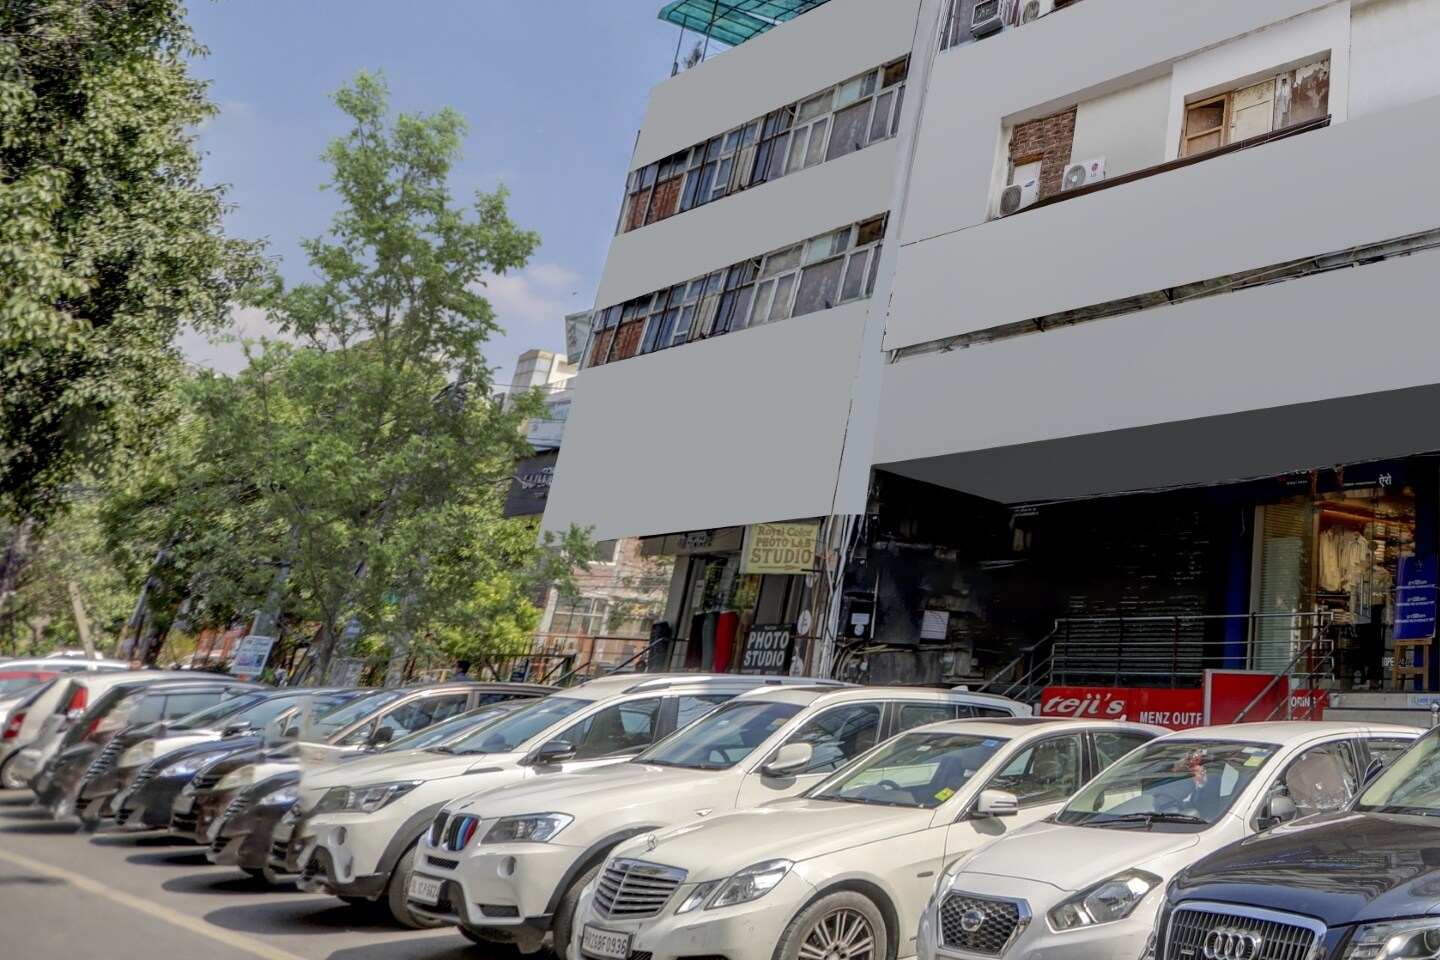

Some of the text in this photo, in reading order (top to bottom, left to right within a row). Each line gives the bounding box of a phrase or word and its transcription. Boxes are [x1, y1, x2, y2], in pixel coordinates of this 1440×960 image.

[758, 526, 813, 537] Royal Color
[756, 537, 788, 548] PHOTO
[750, 548, 812, 564] STUDIO
[747, 631, 790, 649] PHOTO
[743, 650, 785, 667] STUDIO
[1043, 693, 1126, 718] teji's
[1139, 711, 1169, 724] MENZ
